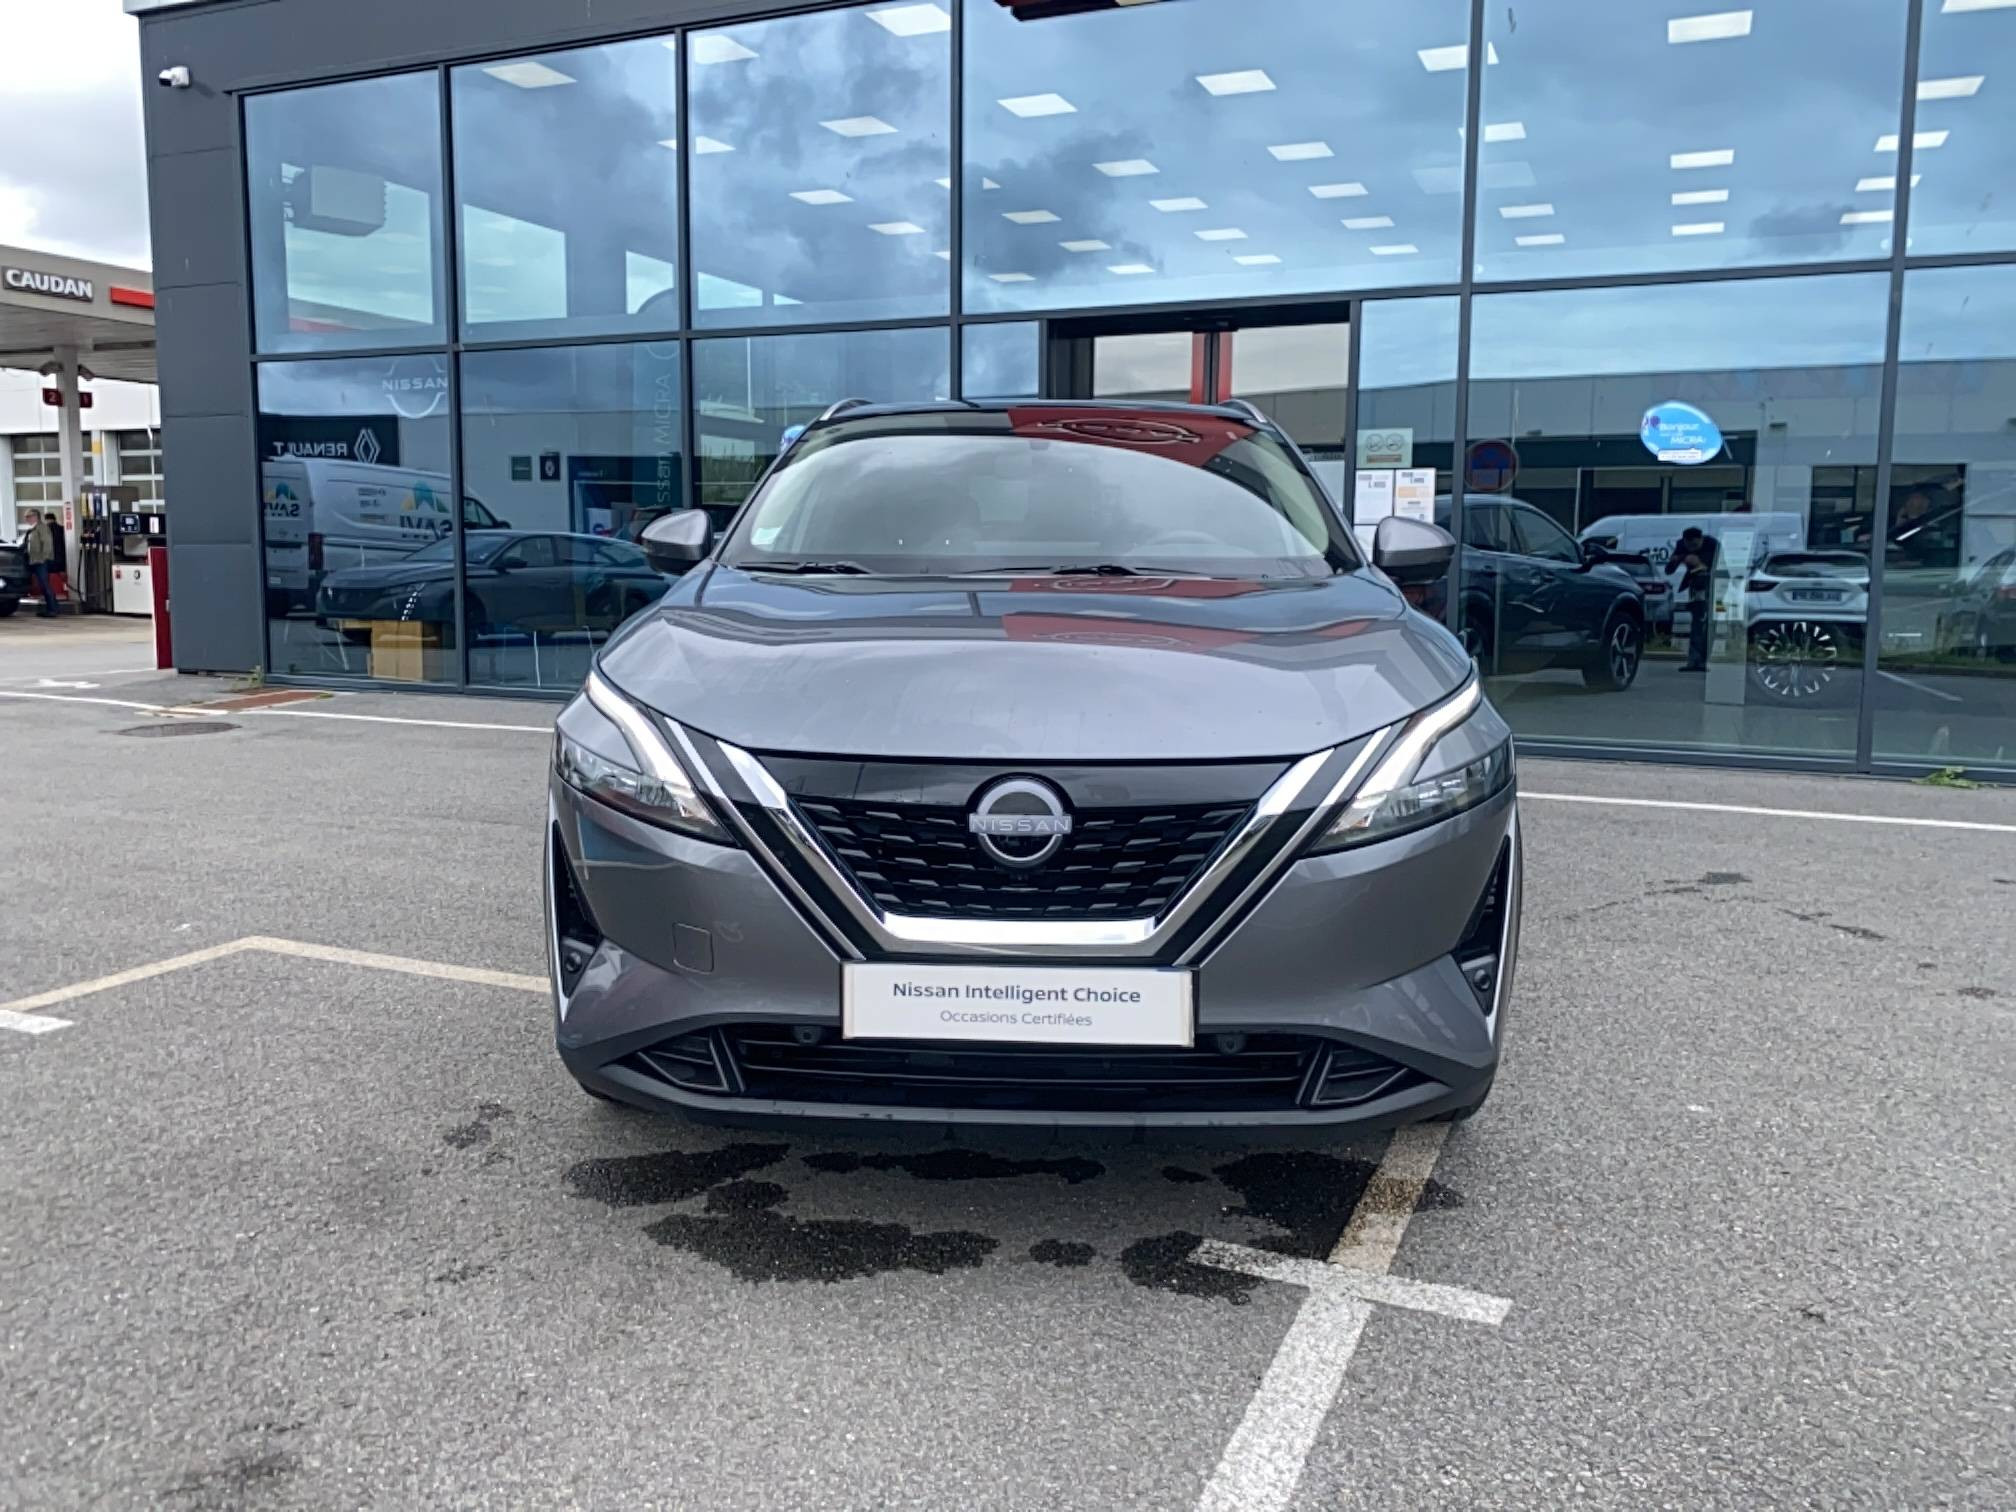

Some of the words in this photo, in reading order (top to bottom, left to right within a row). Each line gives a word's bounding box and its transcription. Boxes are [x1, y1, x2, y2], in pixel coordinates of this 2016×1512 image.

[6, 269, 93, 298] CAUDAN
[382, 376, 449, 391] NISSAN
[654, 373, 672, 445] MICRA
[971, 817, 1070, 833] NISSAN
[893, 982, 960, 999] Nissan
[965, 984, 1069, 1005] Intelligent
[1073, 986, 1142, 1003] Choice
[940, 1010, 1018, 1025] Occasions
[1021, 1012, 1093, 1026] Certifiées
